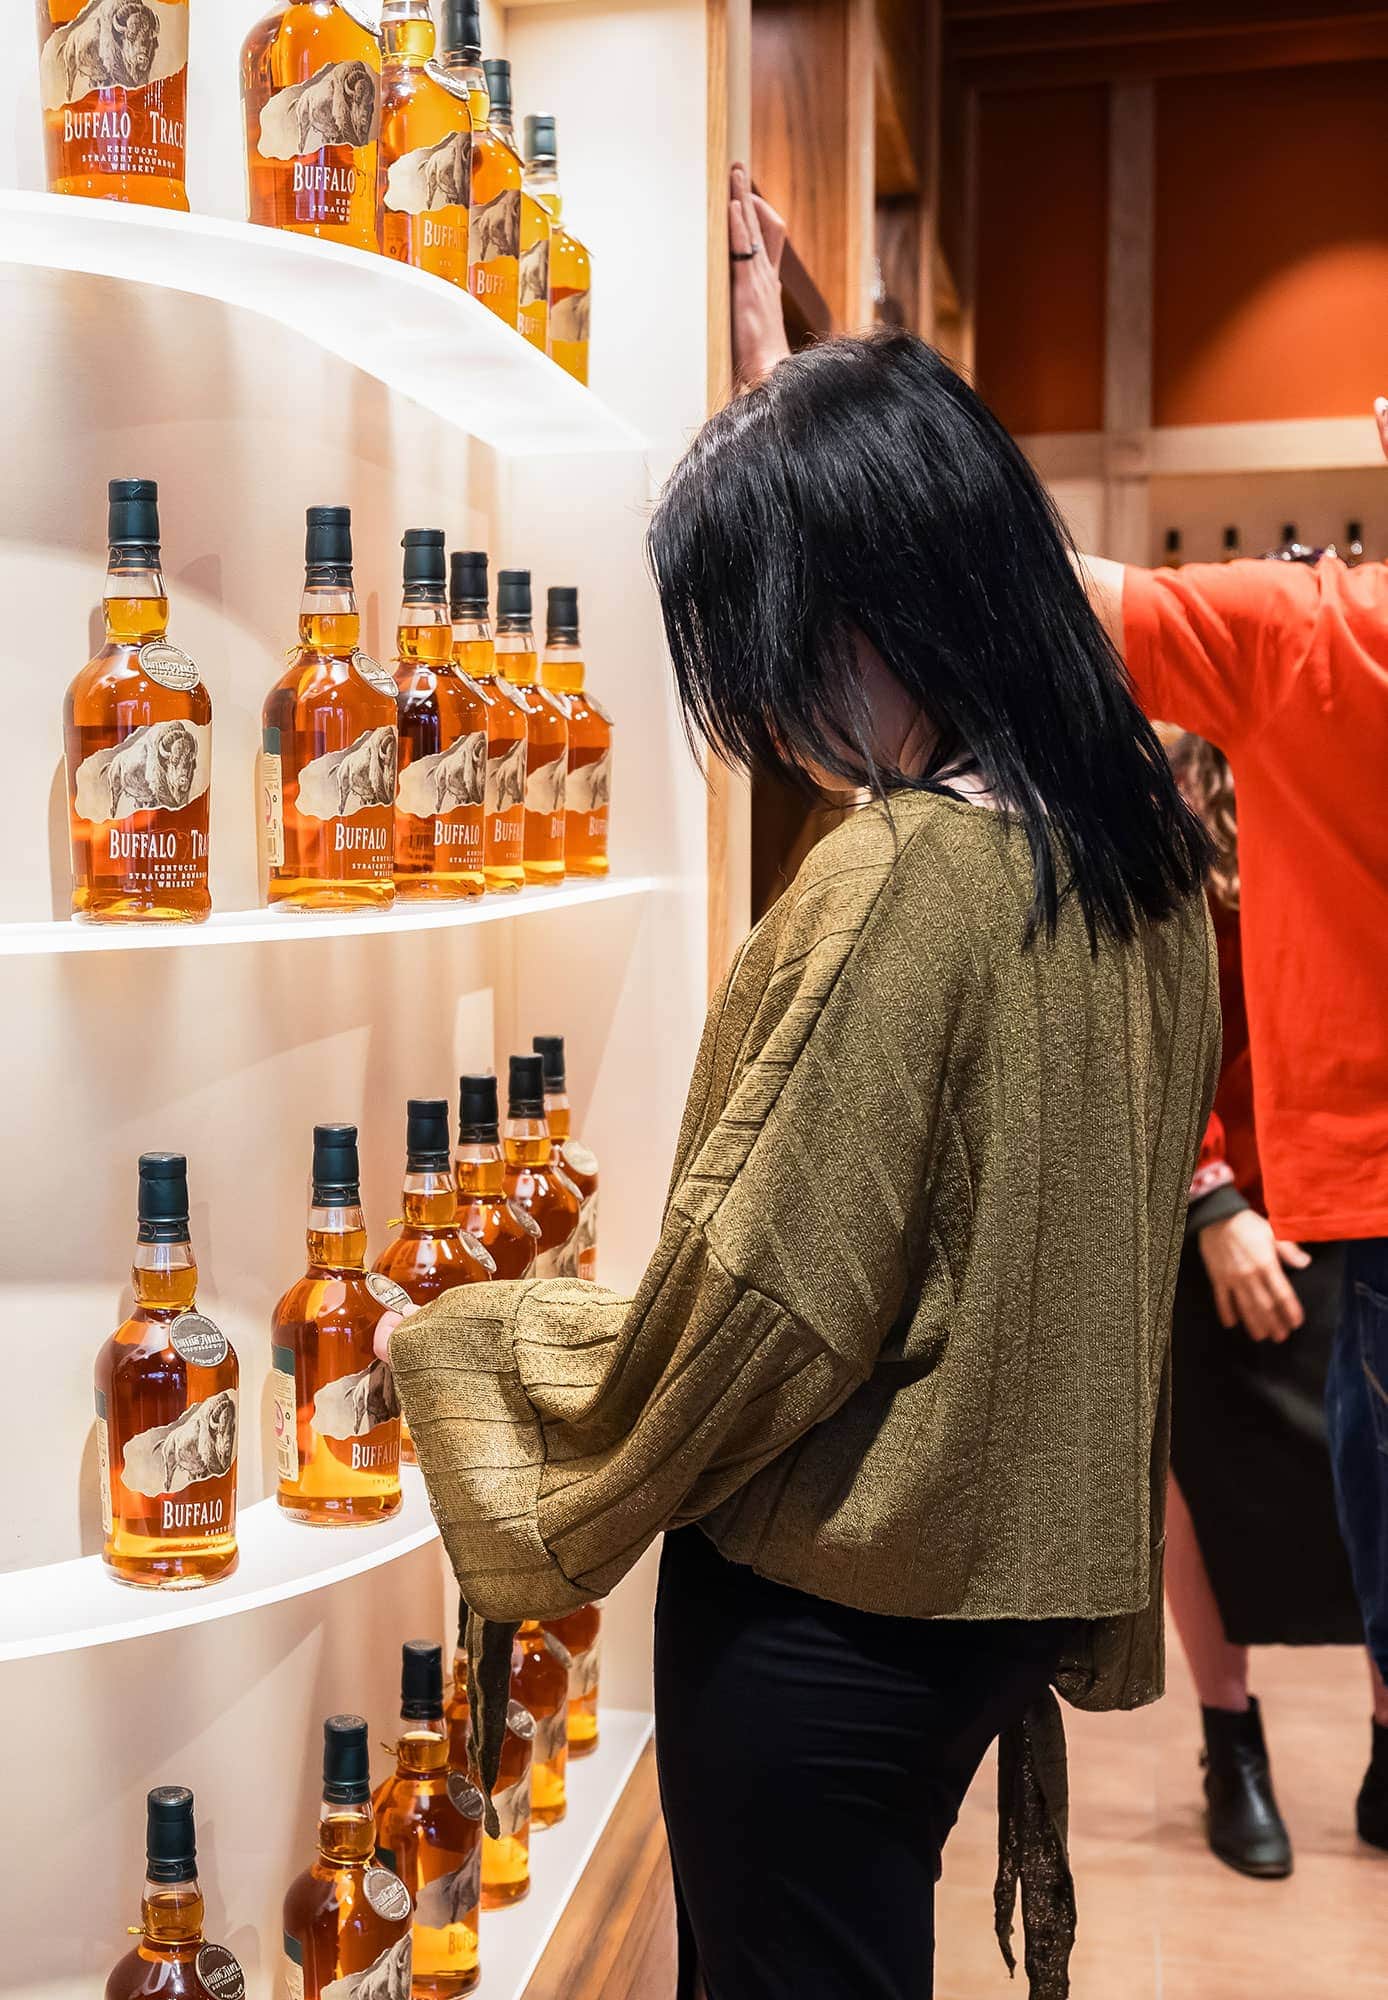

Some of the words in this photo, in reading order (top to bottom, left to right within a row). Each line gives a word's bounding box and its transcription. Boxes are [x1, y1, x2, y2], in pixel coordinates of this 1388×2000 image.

[63, 109, 132, 142] BUFFALO
[149, 110, 184, 149] TRACE
[81, 154, 133, 163] STRAIGHT
[138, 156, 176, 169] BOURBON
[106, 145, 158, 156] KENTUCKY
[110, 163, 155, 174] WHISKEY
[293, 162, 355, 193] BUFFALO
[109, 828, 177, 859] BUFFALO
[334, 823, 387, 851] BUFFALO
[433, 820, 480, 846] BUFFALO
[128, 872, 177, 880] STRAIGHT
[154, 864, 198, 872] KENTUCKY
[157, 880, 195, 889] WHISKEY
[351, 1442, 399, 1470] BUFFALO
[162, 1498, 223, 1529] BUFFALO
